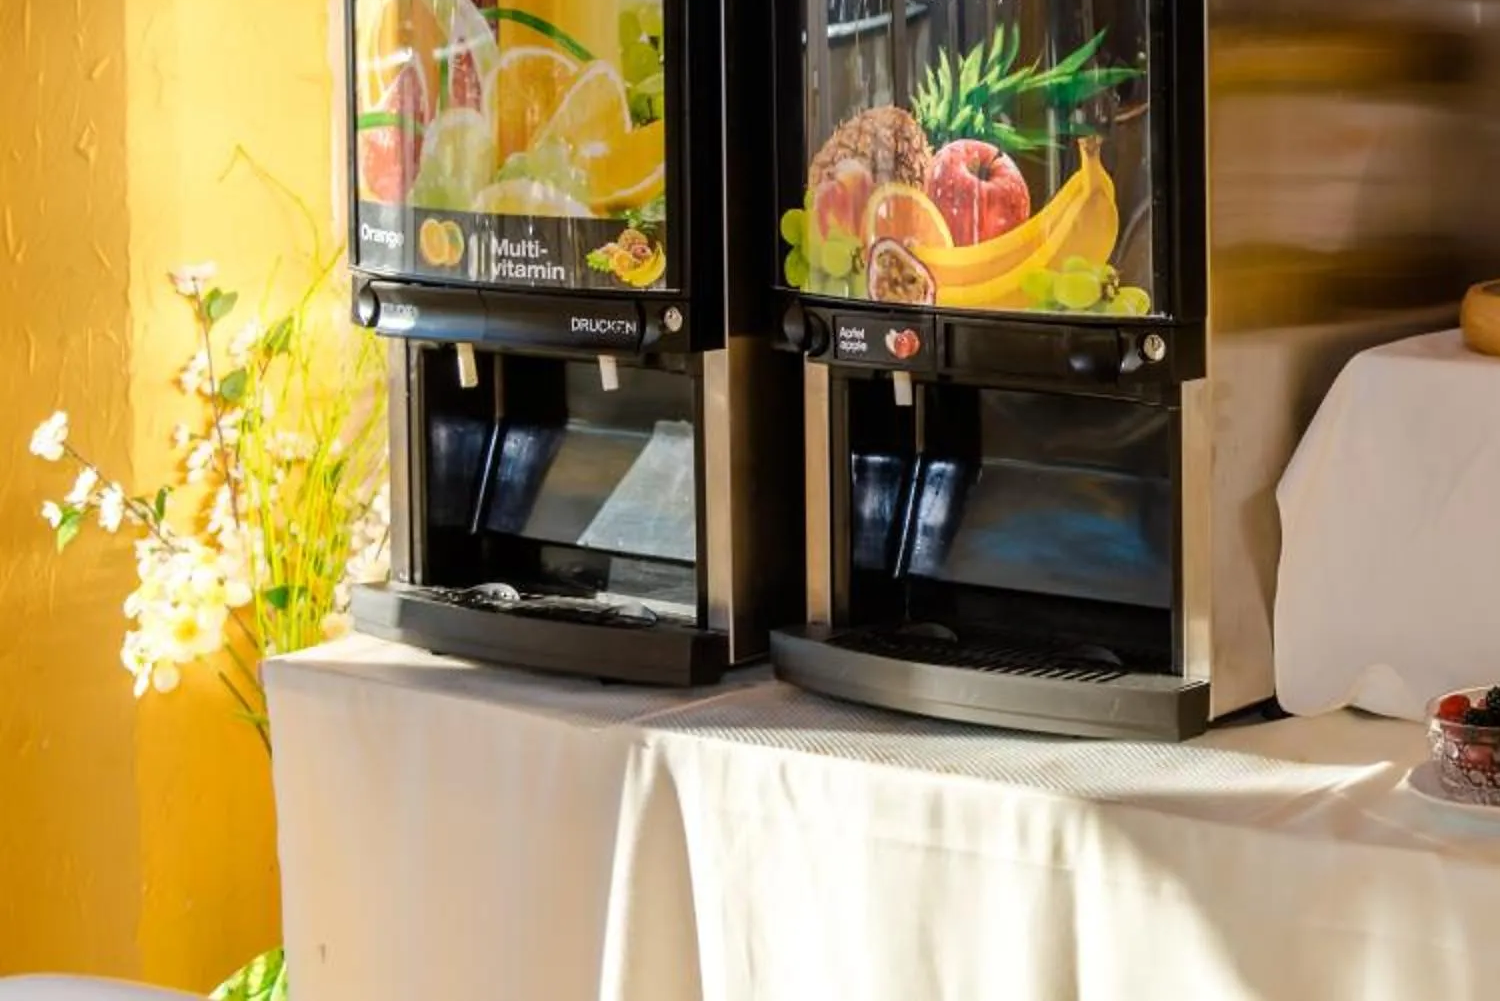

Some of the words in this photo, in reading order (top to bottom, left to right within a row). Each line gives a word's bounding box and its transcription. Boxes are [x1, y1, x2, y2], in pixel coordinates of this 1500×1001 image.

[361, 222, 405, 249] Orange
[492, 238, 549, 258] Multi-
[492, 259, 565, 280] vitamin
